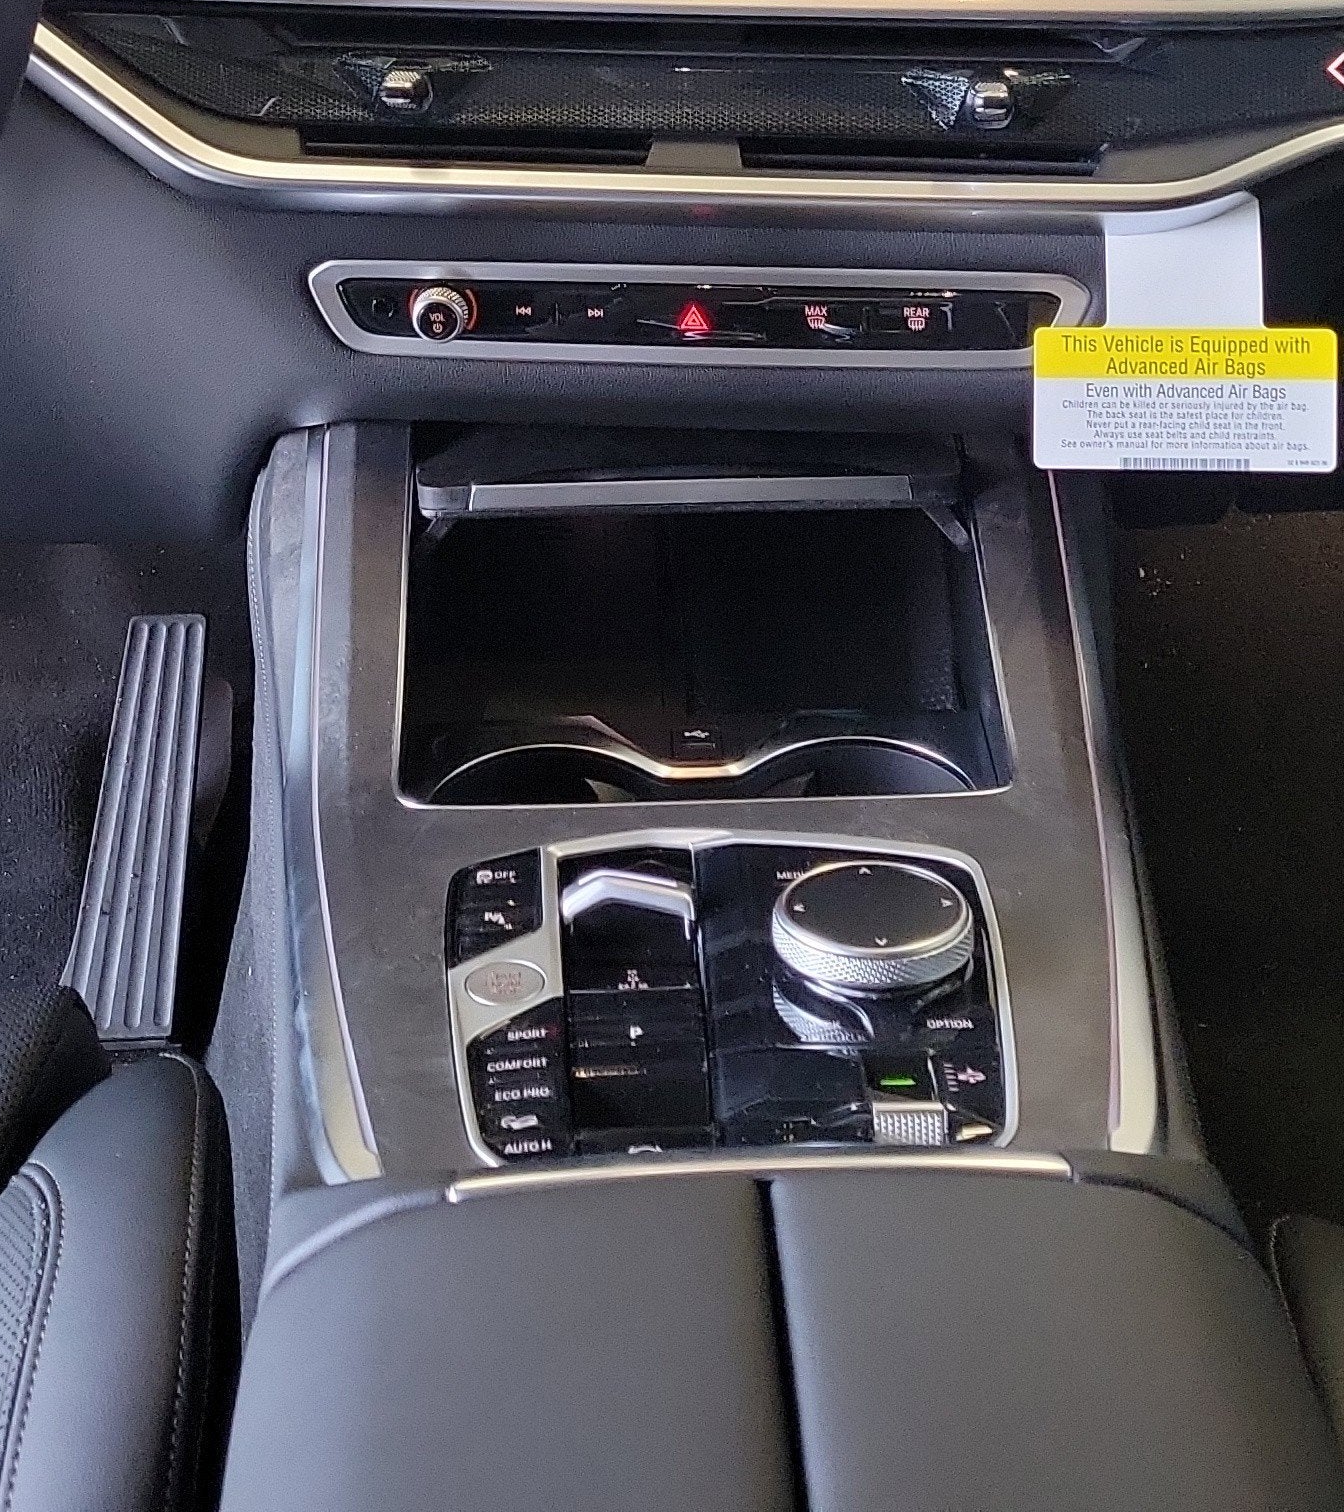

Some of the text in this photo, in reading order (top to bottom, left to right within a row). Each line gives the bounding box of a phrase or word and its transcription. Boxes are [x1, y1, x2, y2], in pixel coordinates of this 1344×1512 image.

[429, 312, 445, 322] VOL
[805, 305, 828, 317] MAX
[904, 307, 929, 318] REAR
[1061, 335, 1310, 356] This Vehicle is Equipped with
[1106, 357, 1265, 379] Advanced Air Bags
[1086, 383, 1287, 402] Even with Advanced Air Bags
[1062, 399, 1098, 409] Children
[1101, 401, 1116, 409] can
[1119, 400, 1130, 409] be
[1133, 400, 1156, 409] killed
[1171, 400, 1210, 411] seriously
[1213, 401, 1244, 412] injured
[1247, 401, 1256, 412] by
[1260, 402, 1274, 410] the
[1277, 402, 1288, 410] air
[1291, 402, 1309, 412] bag.
[1087, 410, 1285, 421] The back seat is the safest place for children.
[1086, 420, 1110, 429] Never
[1114, 421, 1128, 430] put
[1139, 420, 1186, 430] rear-facing
[1188, 421, 1210, 429] child
[1213, 421, 1231, 429] seat
[1234, 421, 1242, 429] in
[1245, 421, 1258, 429] the
[1261, 422, 1285, 430] front.
[1093, 430, 1125, 440] Always
[1145, 431, 1163, 439] seat
[1166, 430, 1187, 439] belts
[1190, 431, 1206, 439] and
[1208, 431, 1230, 439] child
[1061, 439, 1077, 448] See
[1080, 440, 1113, 448] owner's
[1117, 440, 1148, 449] manual
[1151, 440, 1163, 449] for
[1166, 441, 1188, 449] more
[1191, 441, 1242, 450] information
[1245, 441, 1269, 450] about
[1272, 442, 1284, 450] air
[927, 1018, 973, 1029] OPTION
[507, 1028, 547, 1041] SPORT
[486, 1056, 548, 1072] COMFORT
[495, 1087, 550, 1101] ECO PRO
[504, 1140, 540, 1154] AUTO
